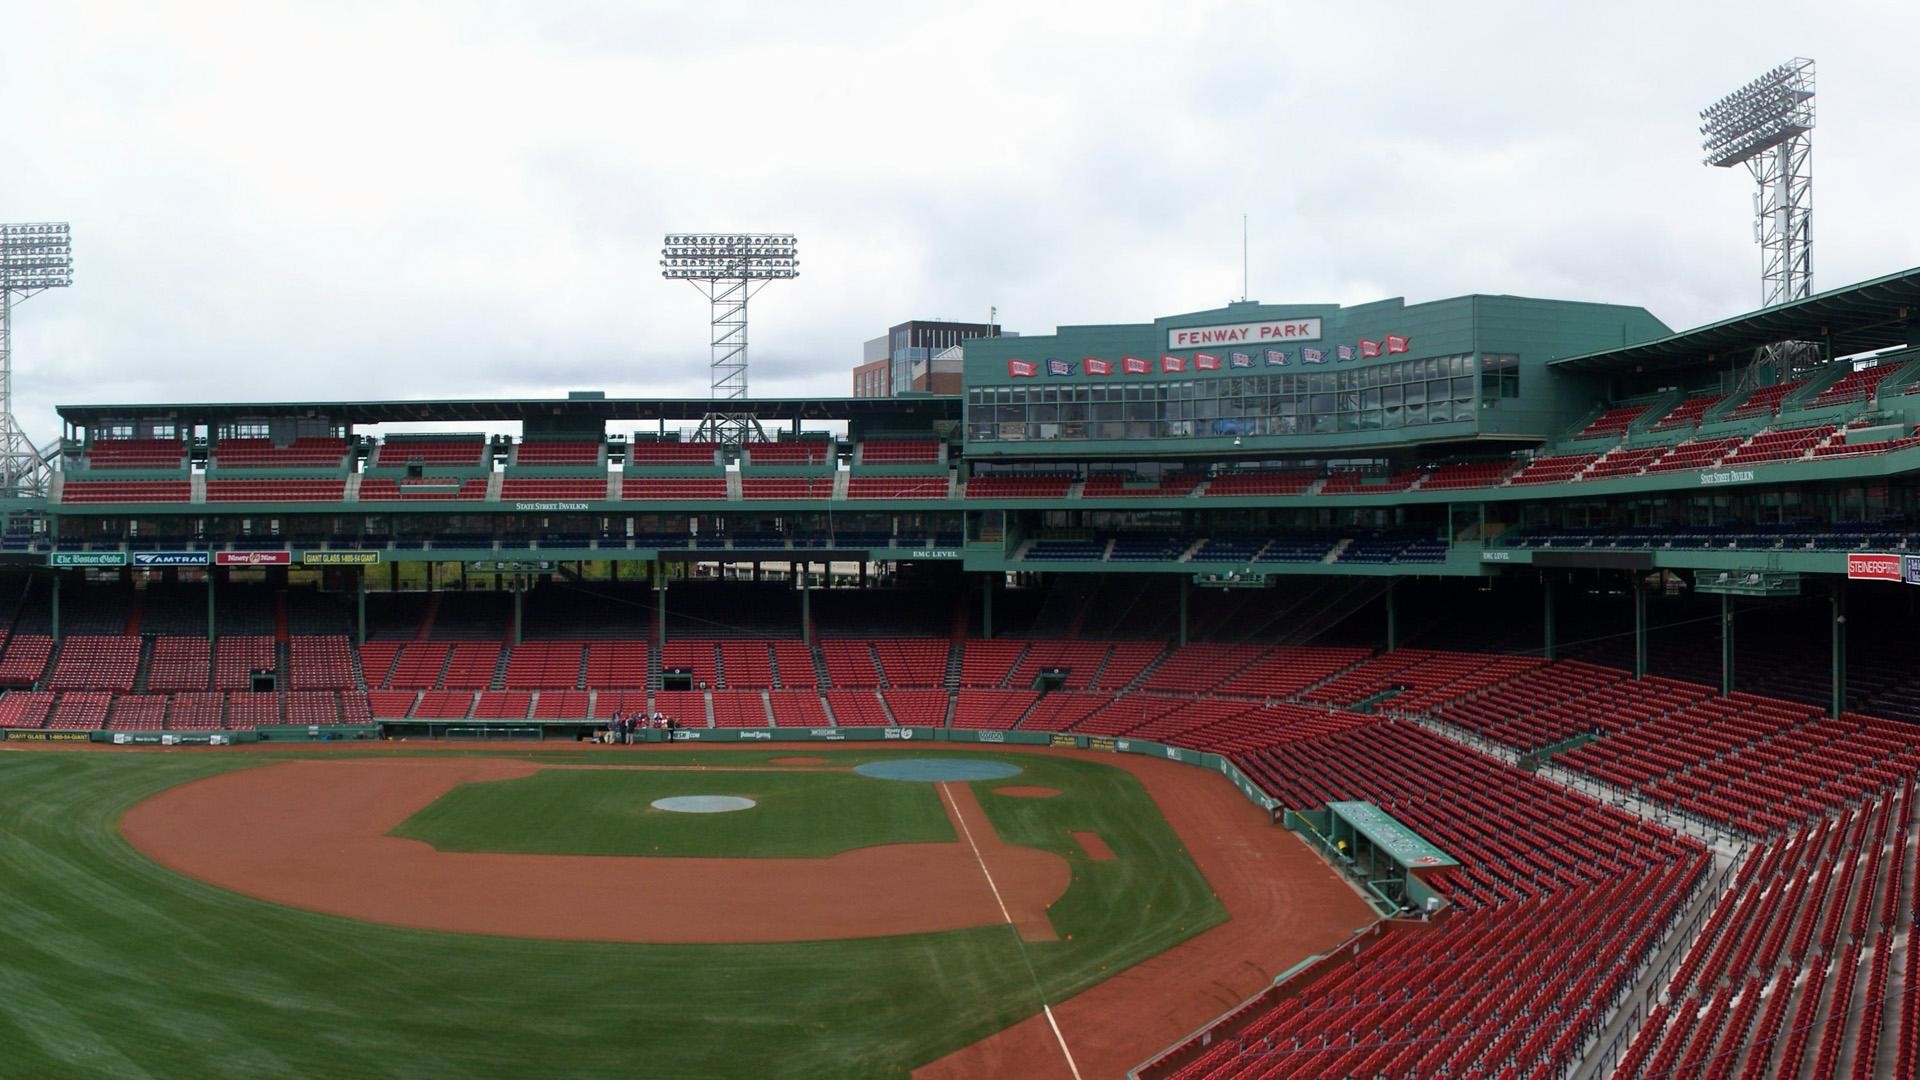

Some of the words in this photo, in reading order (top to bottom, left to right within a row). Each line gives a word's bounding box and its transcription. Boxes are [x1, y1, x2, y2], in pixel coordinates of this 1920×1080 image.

[1178, 328, 1249, 344] FENWAY
[1260, 323, 1310, 339] PARK
[516, 502, 534, 510] STATE
[535, 502, 557, 510] STREET
[559, 502, 589, 510] PAVILION
[57, 554, 70, 563] The
[72, 554, 98, 563] Boston
[99, 554, 121, 563] Globe
[1849, 560, 1899, 575] STEINERSP
